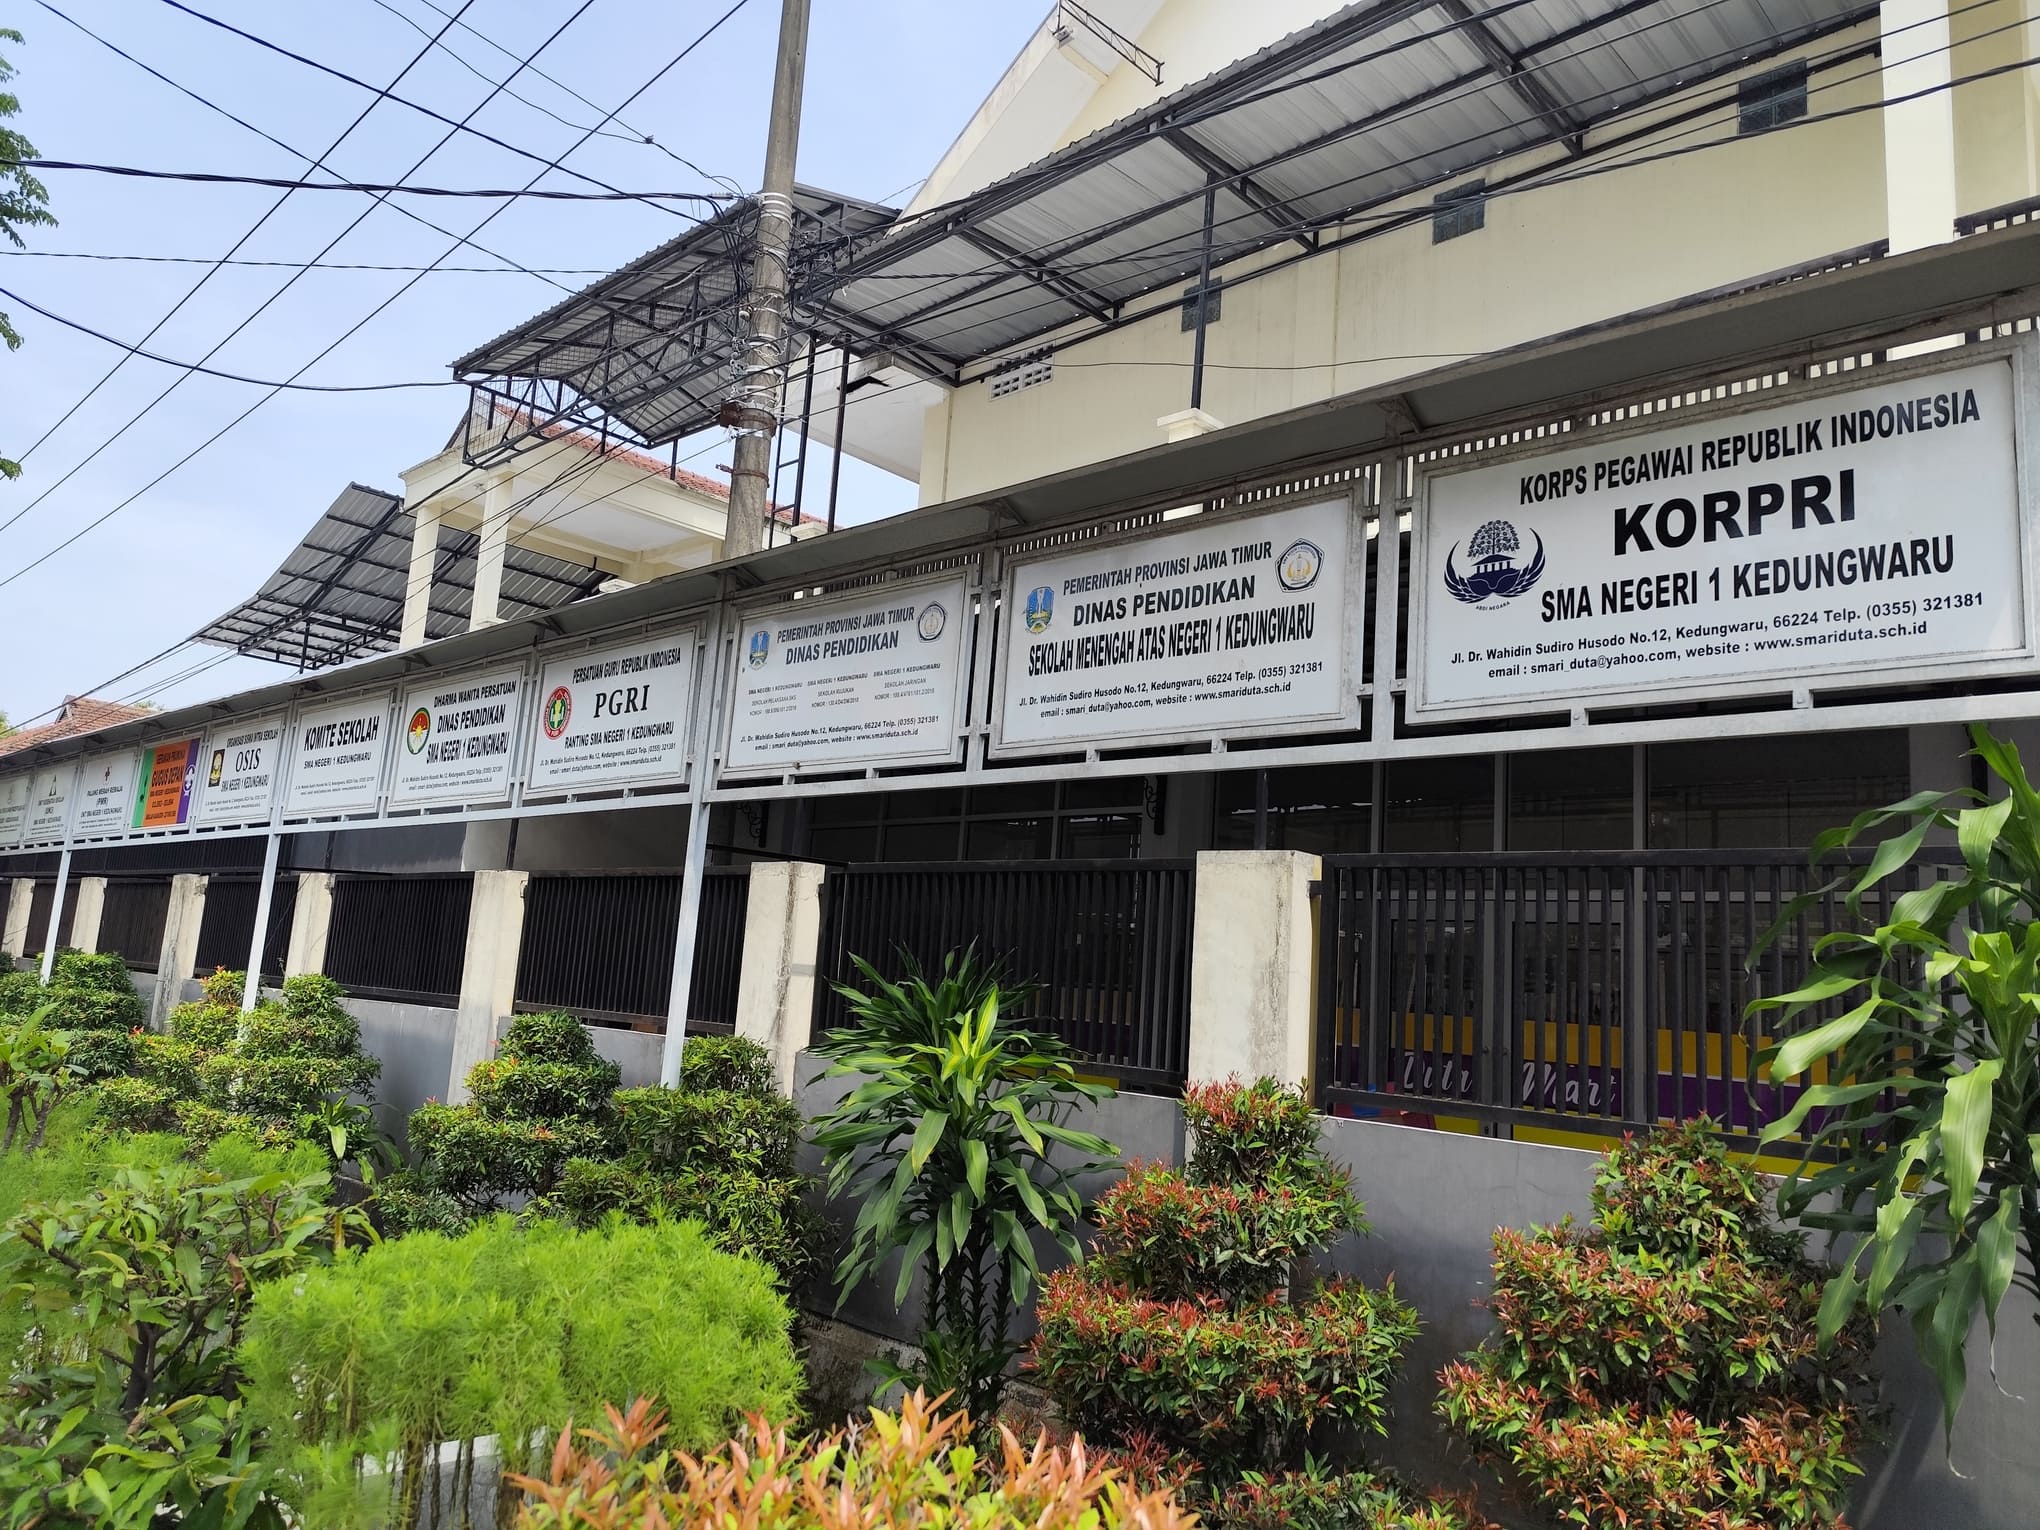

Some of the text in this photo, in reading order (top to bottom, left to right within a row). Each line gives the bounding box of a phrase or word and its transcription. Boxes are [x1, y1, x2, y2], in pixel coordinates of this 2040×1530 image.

[1520, 388, 1979, 505] KORPS PEGAWAI REPUBLIK INDONESIA
[1614, 468, 1854, 556] KORPRI
[1063, 567, 1132, 595] PEMERINTAH
[1135, 556, 1189, 582] PROVINSI
[1193, 550, 1227, 572] JAWA
[1231, 541, 1271, 565] TIMUR
[1541, 534, 1953, 622] SMA NEGERI 1 KEDUNGWARU
[1073, 575, 1255, 626] DINAS PENDIDIKAN
[777, 606, 914, 643] PEMERINTAH PROVINSI JAWA TIMUR
[1028, 602, 1314, 676] SEKOLAH MENENGAH ATAS NEGERI 1 KEDUNGWARU
[1451, 592, 1981, 664] Jl. Dr. Wahidin Sudiro Husodo No.12, Kedungwaru, 66224 Telp. (0355) 321381
[621, 654, 649, 674] REPUBLIK
[649, 647, 680, 668] INDONESIA
[786, 630, 899, 664] DINAS PENDIDIKAN
[1488, 664, 1519, 678] email
[1531, 650, 1680, 673] smari_duta@yahoo.com,
[1685, 642, 1740, 657] website
[1754, 620, 1926, 650] www.smariduta.sch.id
[481, 680, 516, 698] PERSATUAN
[593, 684, 649, 718] PGRI
[1029, 696, 1038, 705] Dr.
[1040, 693, 1067, 703] Wahidin
[1069, 690, 1092, 700] Sudiro
[1094, 686, 1121, 697] Husodo
[1124, 682, 1148, 694] No.12,
[1151, 678, 1203, 690] Kedungwaru,
[1206, 672, 1232, 684] 66224
[1235, 670, 1255, 682] Telp.
[1258, 666, 1286, 680] (0355)
[1289, 661, 1322, 674] 321381
[1040, 707, 1059, 718] email
[1155, 694, 1187, 705] website
[1194, 681, 1291, 701] www.smariduta.sch.id
[304, 715, 379, 751] KOMITE SEKOLAH
[437, 704, 505, 733] DINAS PENDIDIKAN
[565, 734, 589, 748] RANTING
[590, 732, 601, 745] SMA
[603, 729, 625, 743] NEGERI
[631, 721, 674, 739] KEDUNGWARU
[235, 748, 261, 772] OSIS
[440, 739, 461, 761] NEGERI
